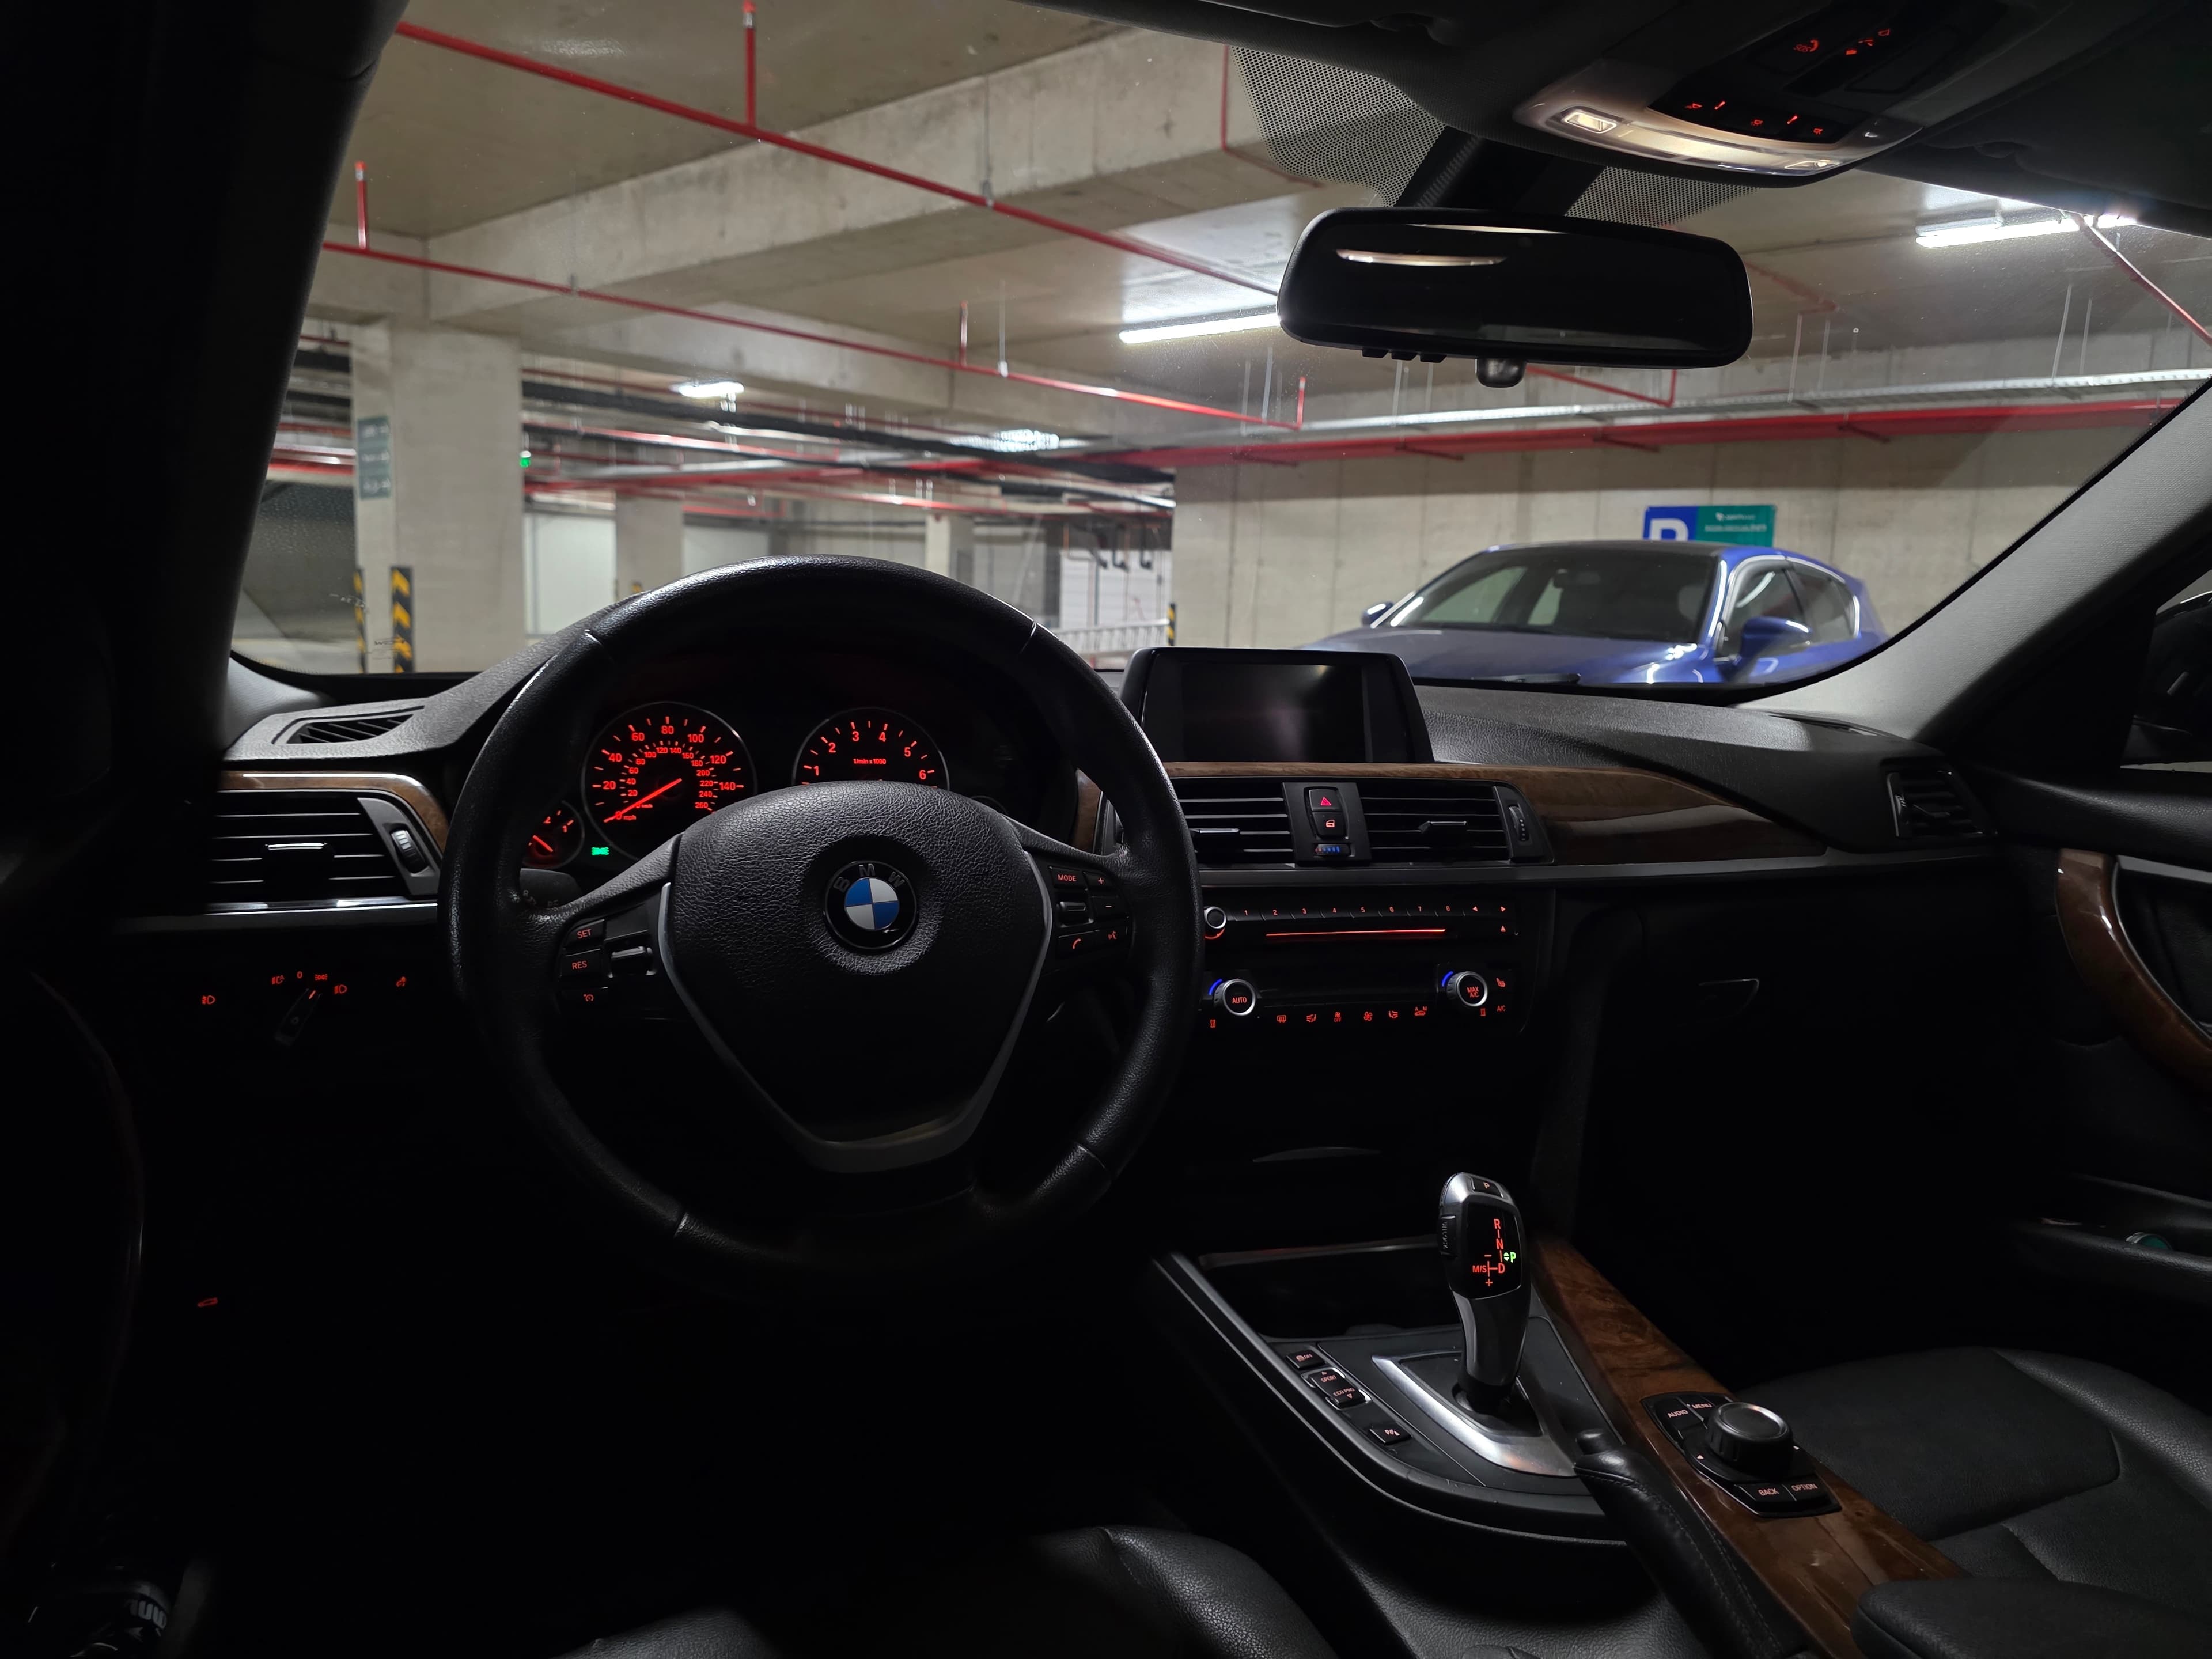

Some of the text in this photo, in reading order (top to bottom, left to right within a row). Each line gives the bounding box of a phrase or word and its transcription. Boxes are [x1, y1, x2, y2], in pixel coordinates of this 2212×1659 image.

[661, 725, 674, 734] 80
[631, 732, 645, 741] 60
[687, 733, 704, 743] 100
[852, 731, 859, 741] 3
[878, 732, 886, 742] 4
[828, 742, 836, 753] 2
[904, 747, 911, 757] 5
[608, 753, 622, 762] 40
[710, 755, 726, 764] 120
[813, 765, 819, 776] 1
[919, 770, 926, 780] 6
[603, 781, 616, 790] 20
[719, 782, 736, 790] 140
[833, 863, 906, 893] BMW
[577, 929, 592, 939] SET
[572, 960, 588, 970] RES
[1493, 1218, 1501, 1229] R
[1496, 1238, 1504, 1249] N
[1509, 1251, 1517, 1263] P
[1472, 1264, 1487, 1273] M/S
[1498, 1263, 1506, 1274] D
[1320, 1374, 1337, 1383] SPORT
[1667, 1409, 1689, 1418] AUDIO
[1758, 1487, 1779, 1497] BACK
[1791, 1483, 1818, 1492] OPTION
